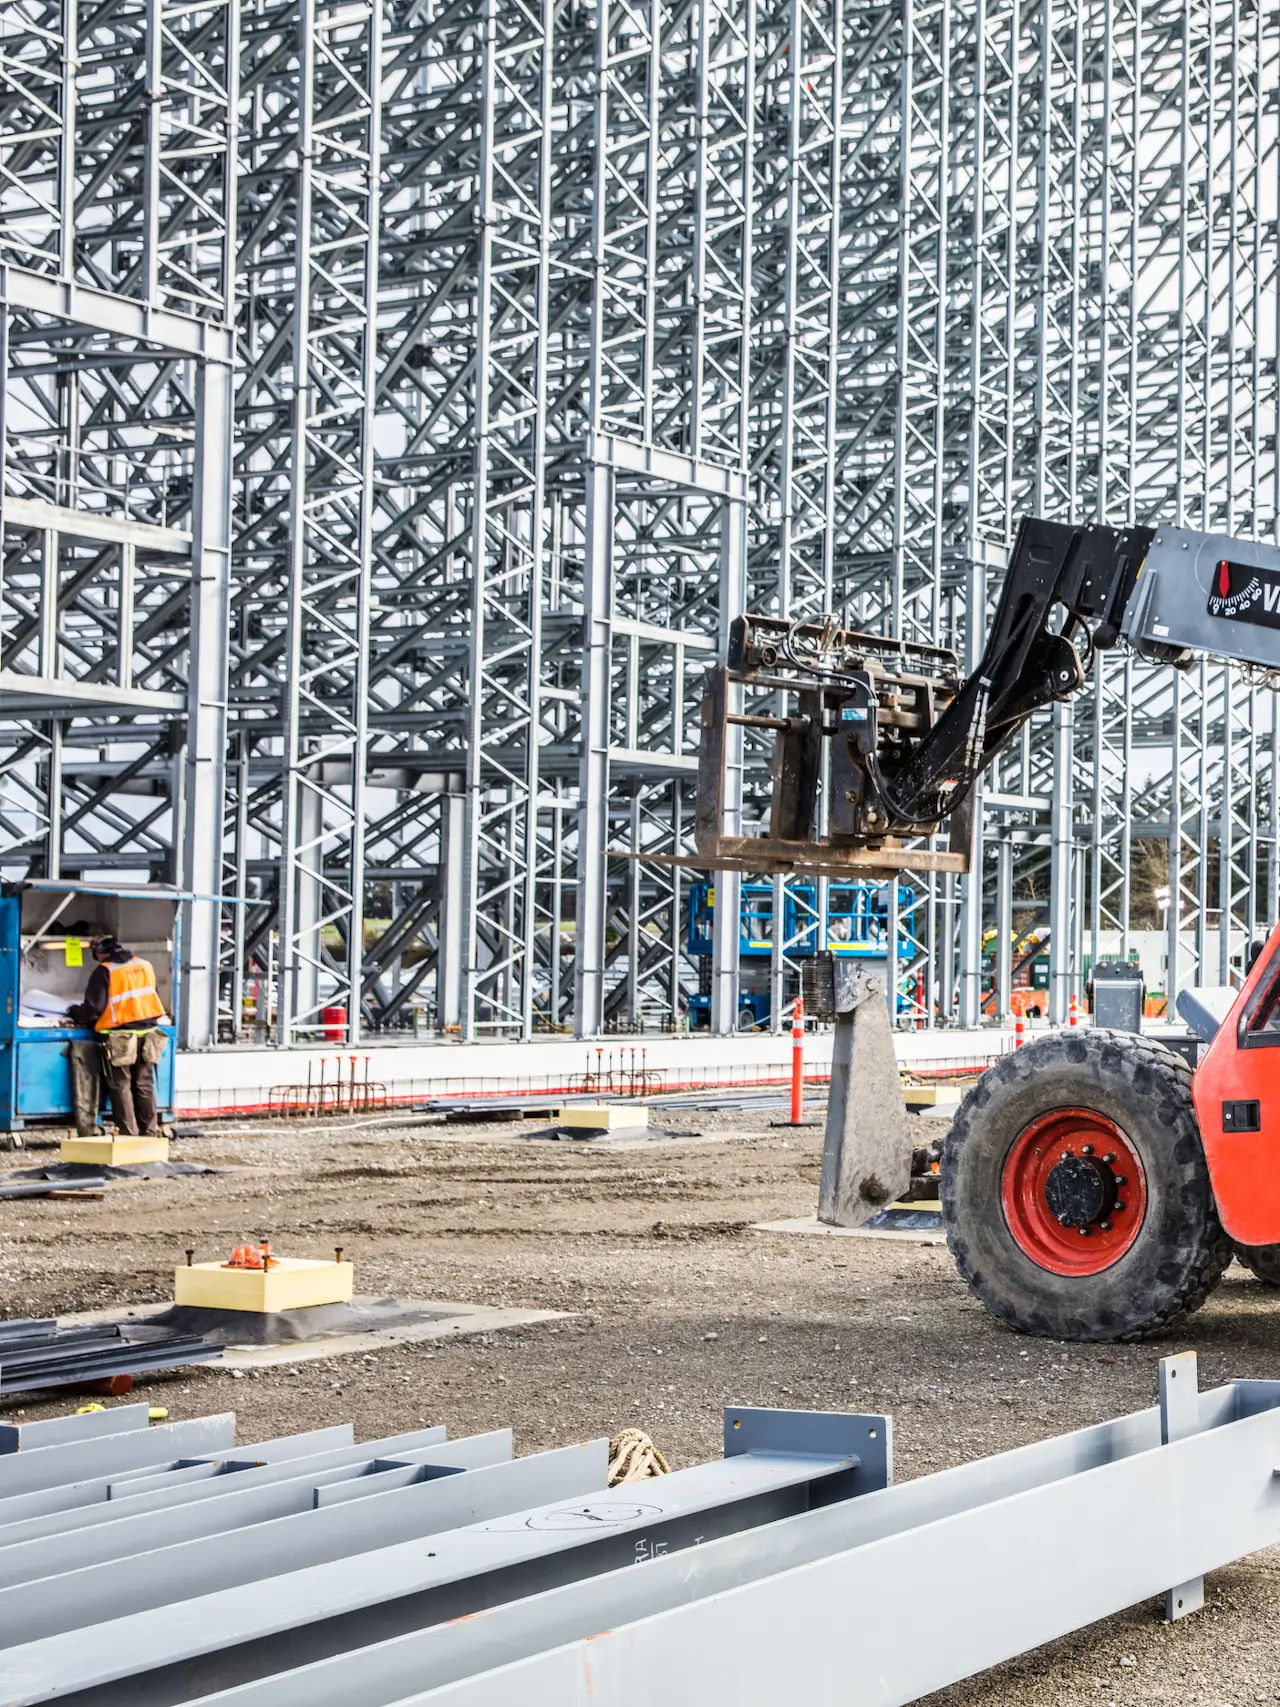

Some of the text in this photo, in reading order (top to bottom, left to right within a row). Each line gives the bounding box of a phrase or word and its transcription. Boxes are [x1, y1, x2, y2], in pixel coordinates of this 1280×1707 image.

[1224, 606, 1237, 616] 20
[1239, 599, 1251, 611] 40
[1251, 587, 1263, 601] 60
